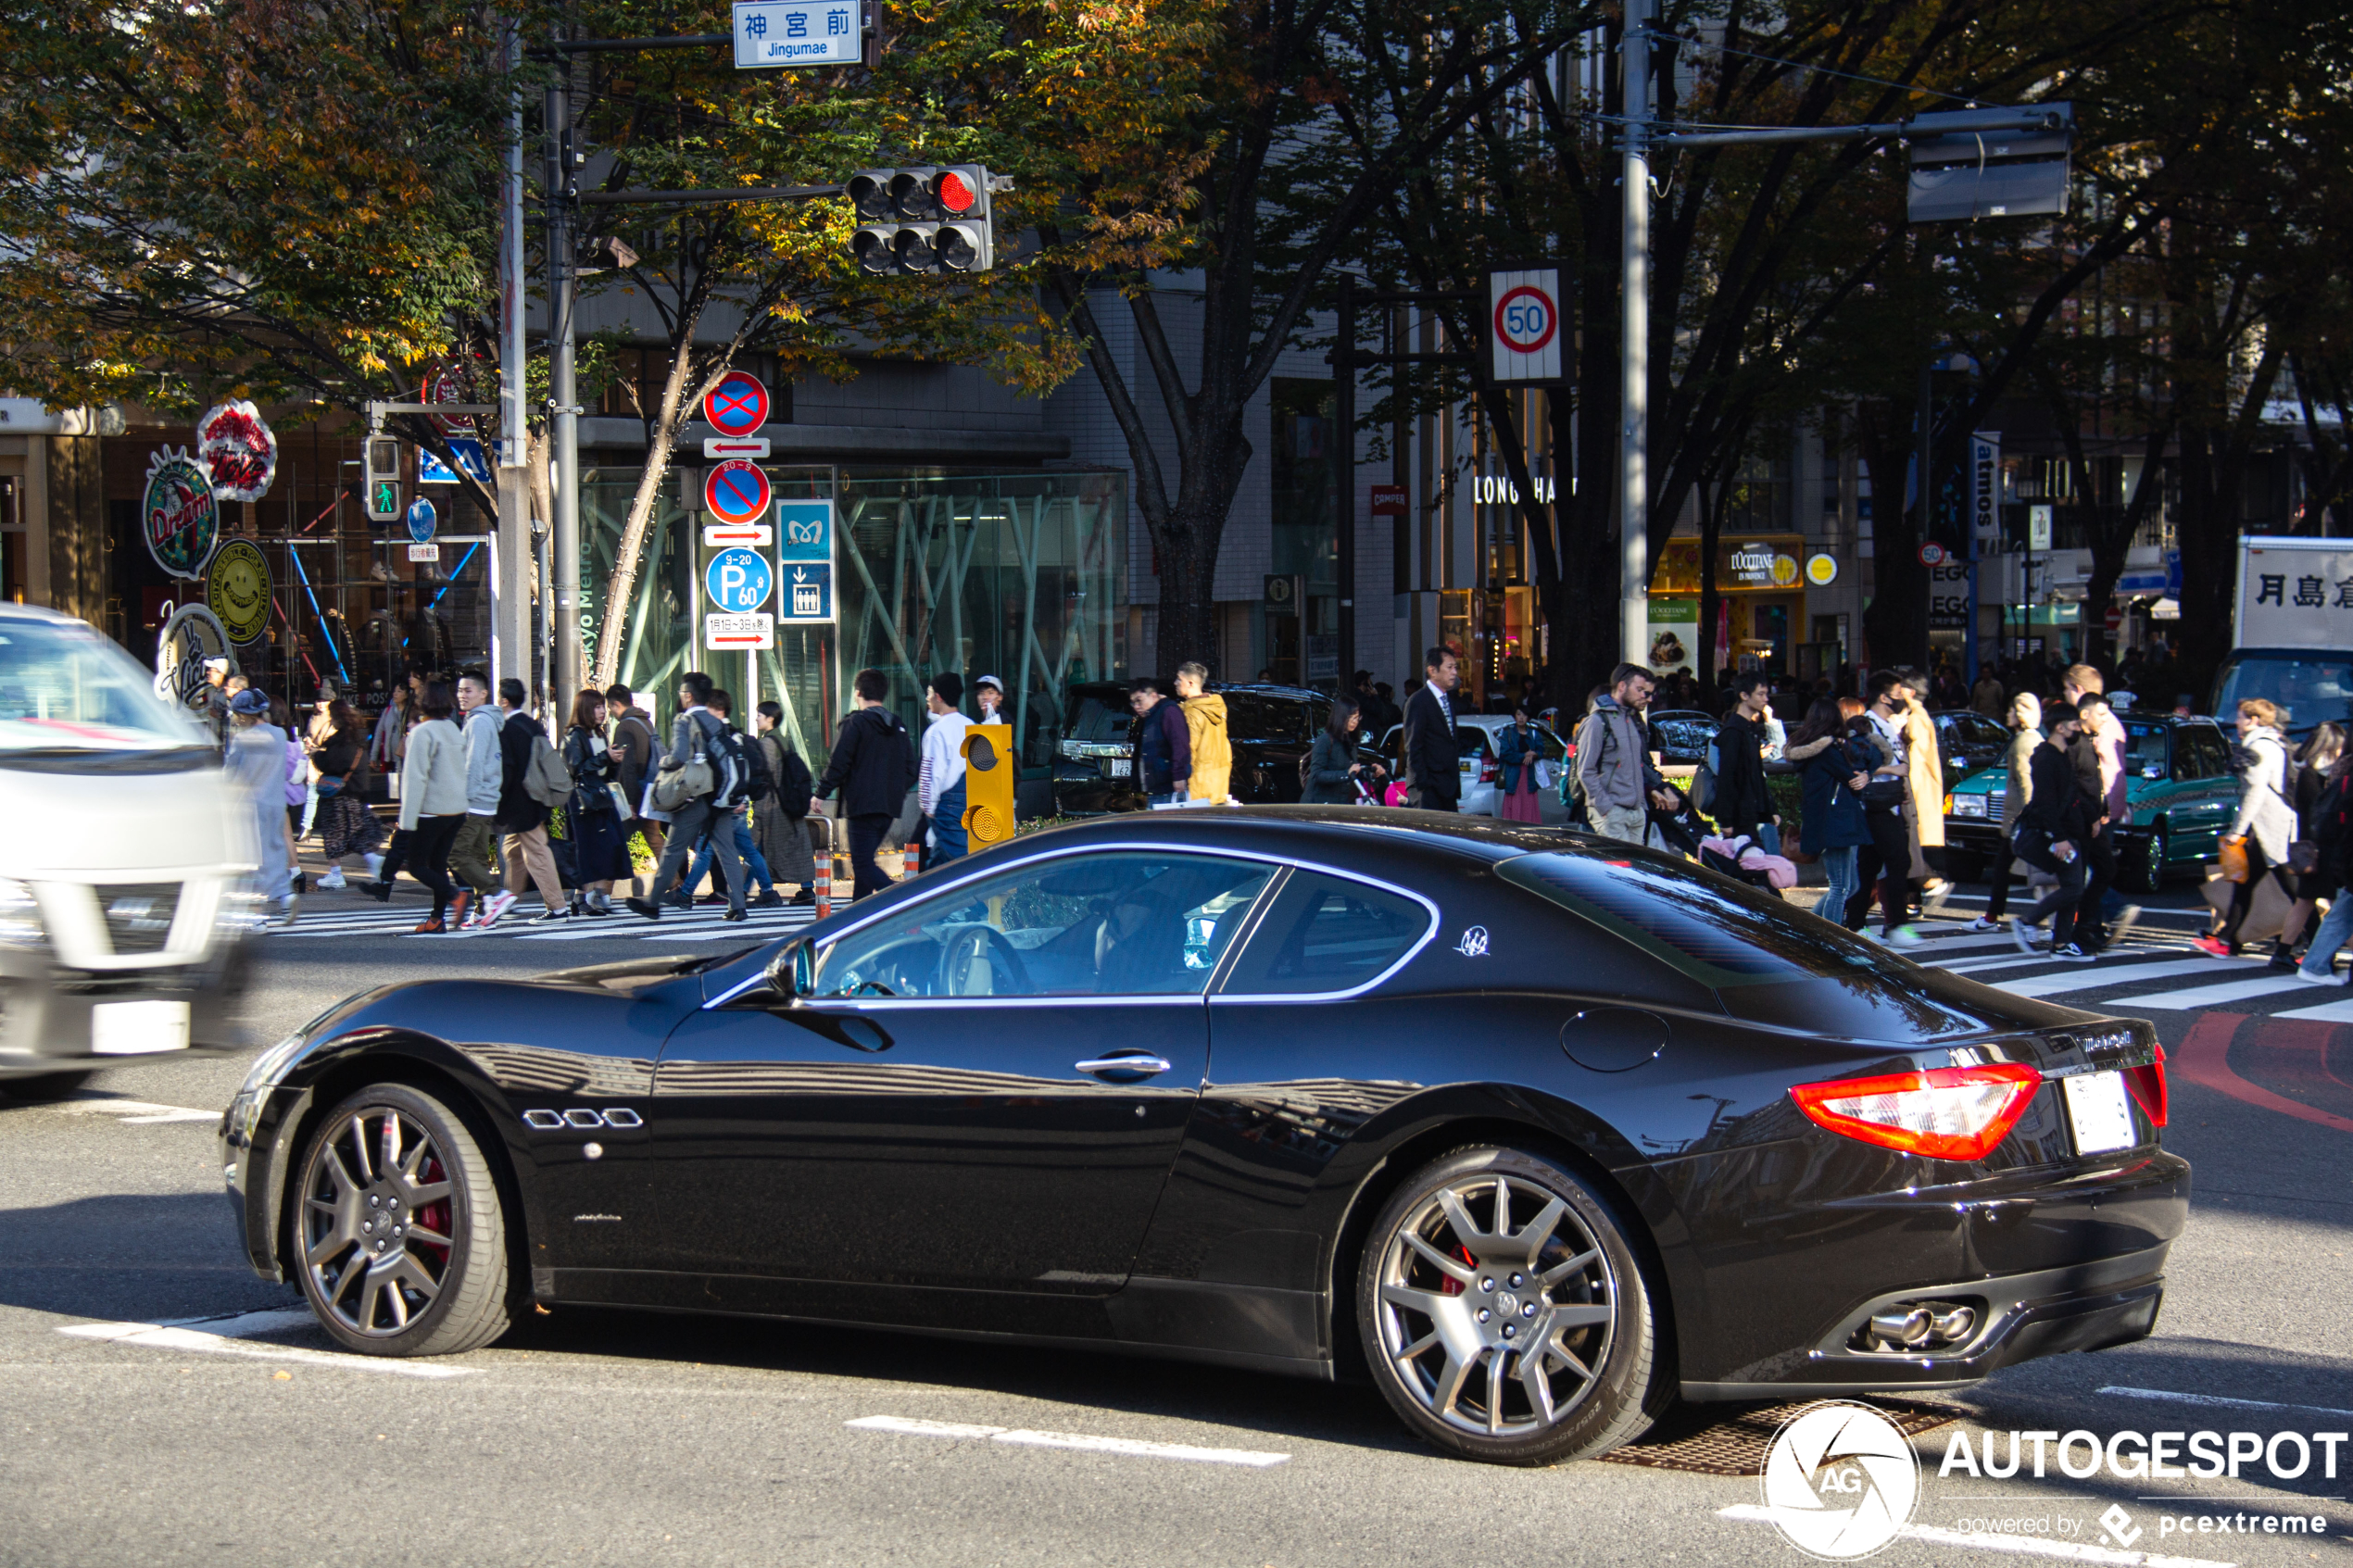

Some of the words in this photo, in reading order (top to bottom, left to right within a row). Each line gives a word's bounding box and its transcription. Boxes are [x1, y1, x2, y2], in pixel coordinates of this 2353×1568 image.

[745, 8, 849, 40] 神宮前
[768, 43, 827, 58] Jingumae
[1508, 306, 1543, 334] 50
[723, 461, 752, 471] 20-9
[1977, 445, 1994, 527] atmos
[1374, 494, 1405, 507] CAMPER
[152, 492, 210, 548] Dream
[725, 555, 752, 565] 9-20
[1730, 551, 1773, 570] L'OCCITANE
[1923, 547, 1940, 560] 50
[580, 542, 593, 608] Metro
[722, 565, 746, 605] P
[738, 587, 757, 605] 60
